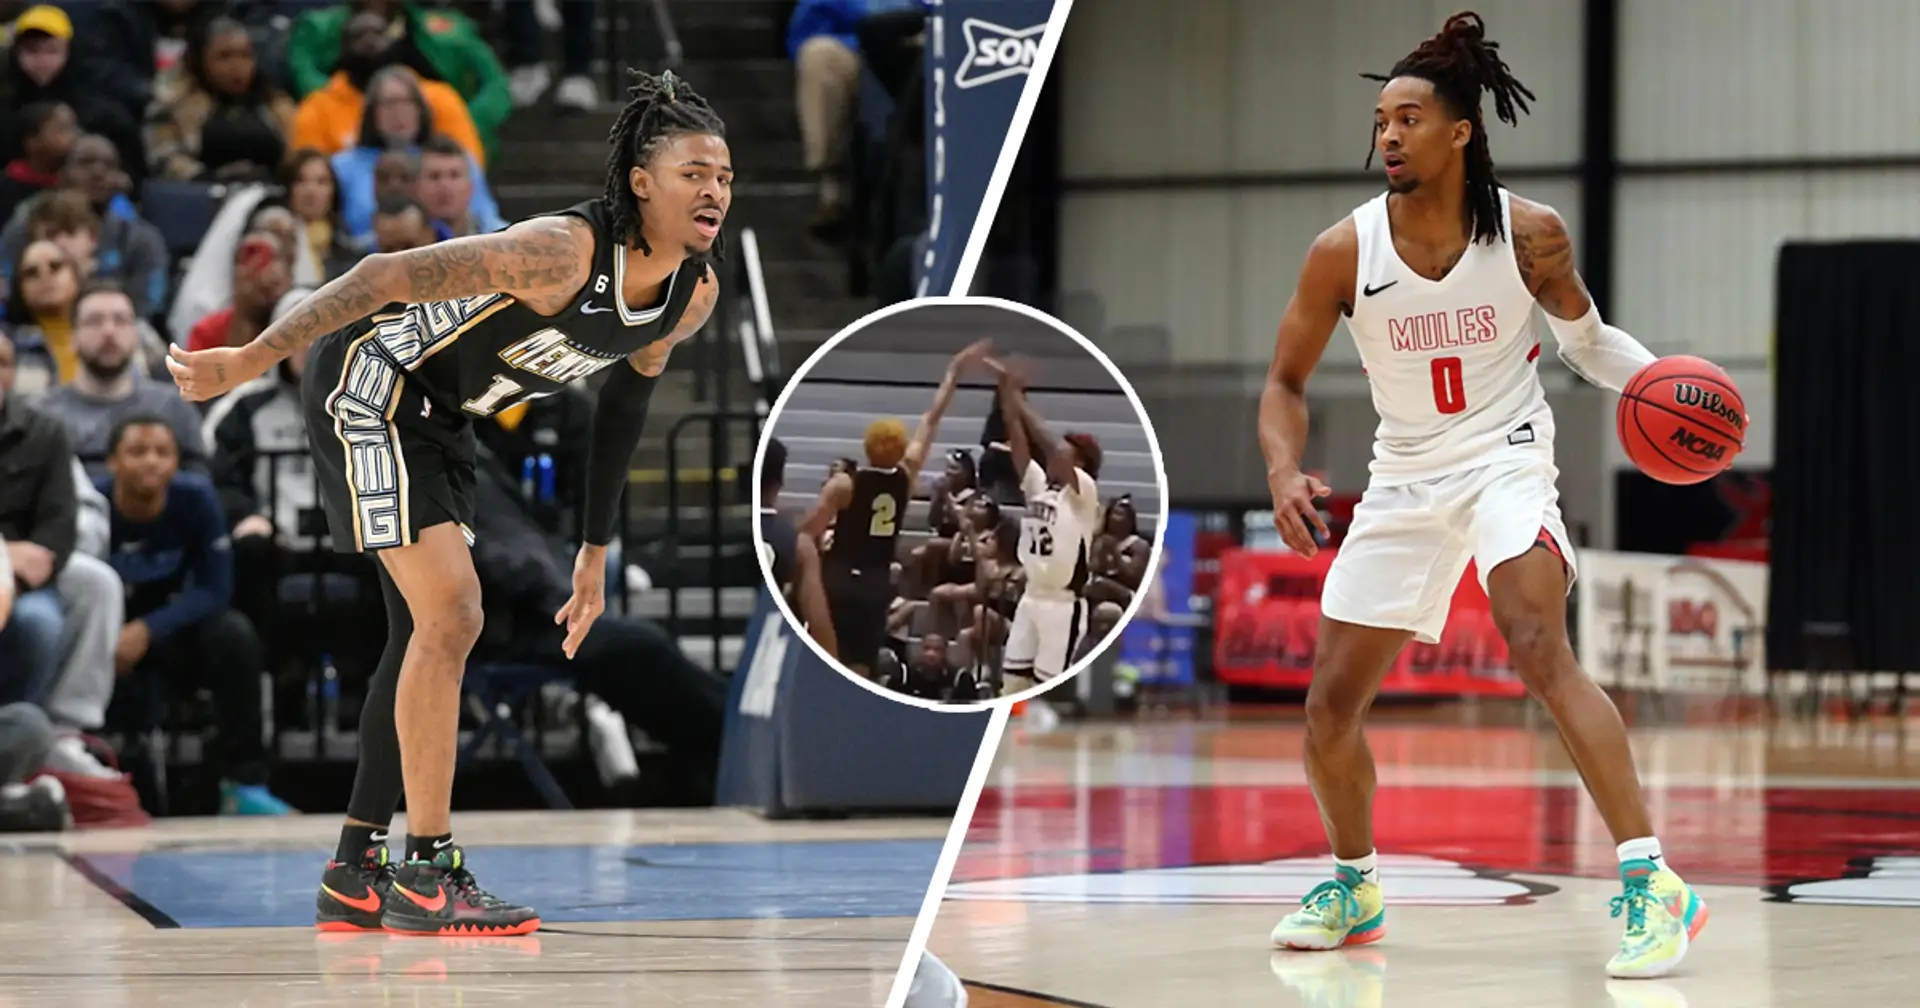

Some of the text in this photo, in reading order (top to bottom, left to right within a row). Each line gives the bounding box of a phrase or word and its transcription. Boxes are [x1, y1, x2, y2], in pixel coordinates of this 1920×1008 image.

[594, 274, 610, 294] 6
[1388, 305, 1498, 352] MULES
[1430, 356, 1467, 415] 0
[1673, 382, 1744, 430] Wilson
[1669, 426, 1727, 462] NCAA
[868, 492, 898, 538] 2
[1026, 525, 1054, 557] 12
